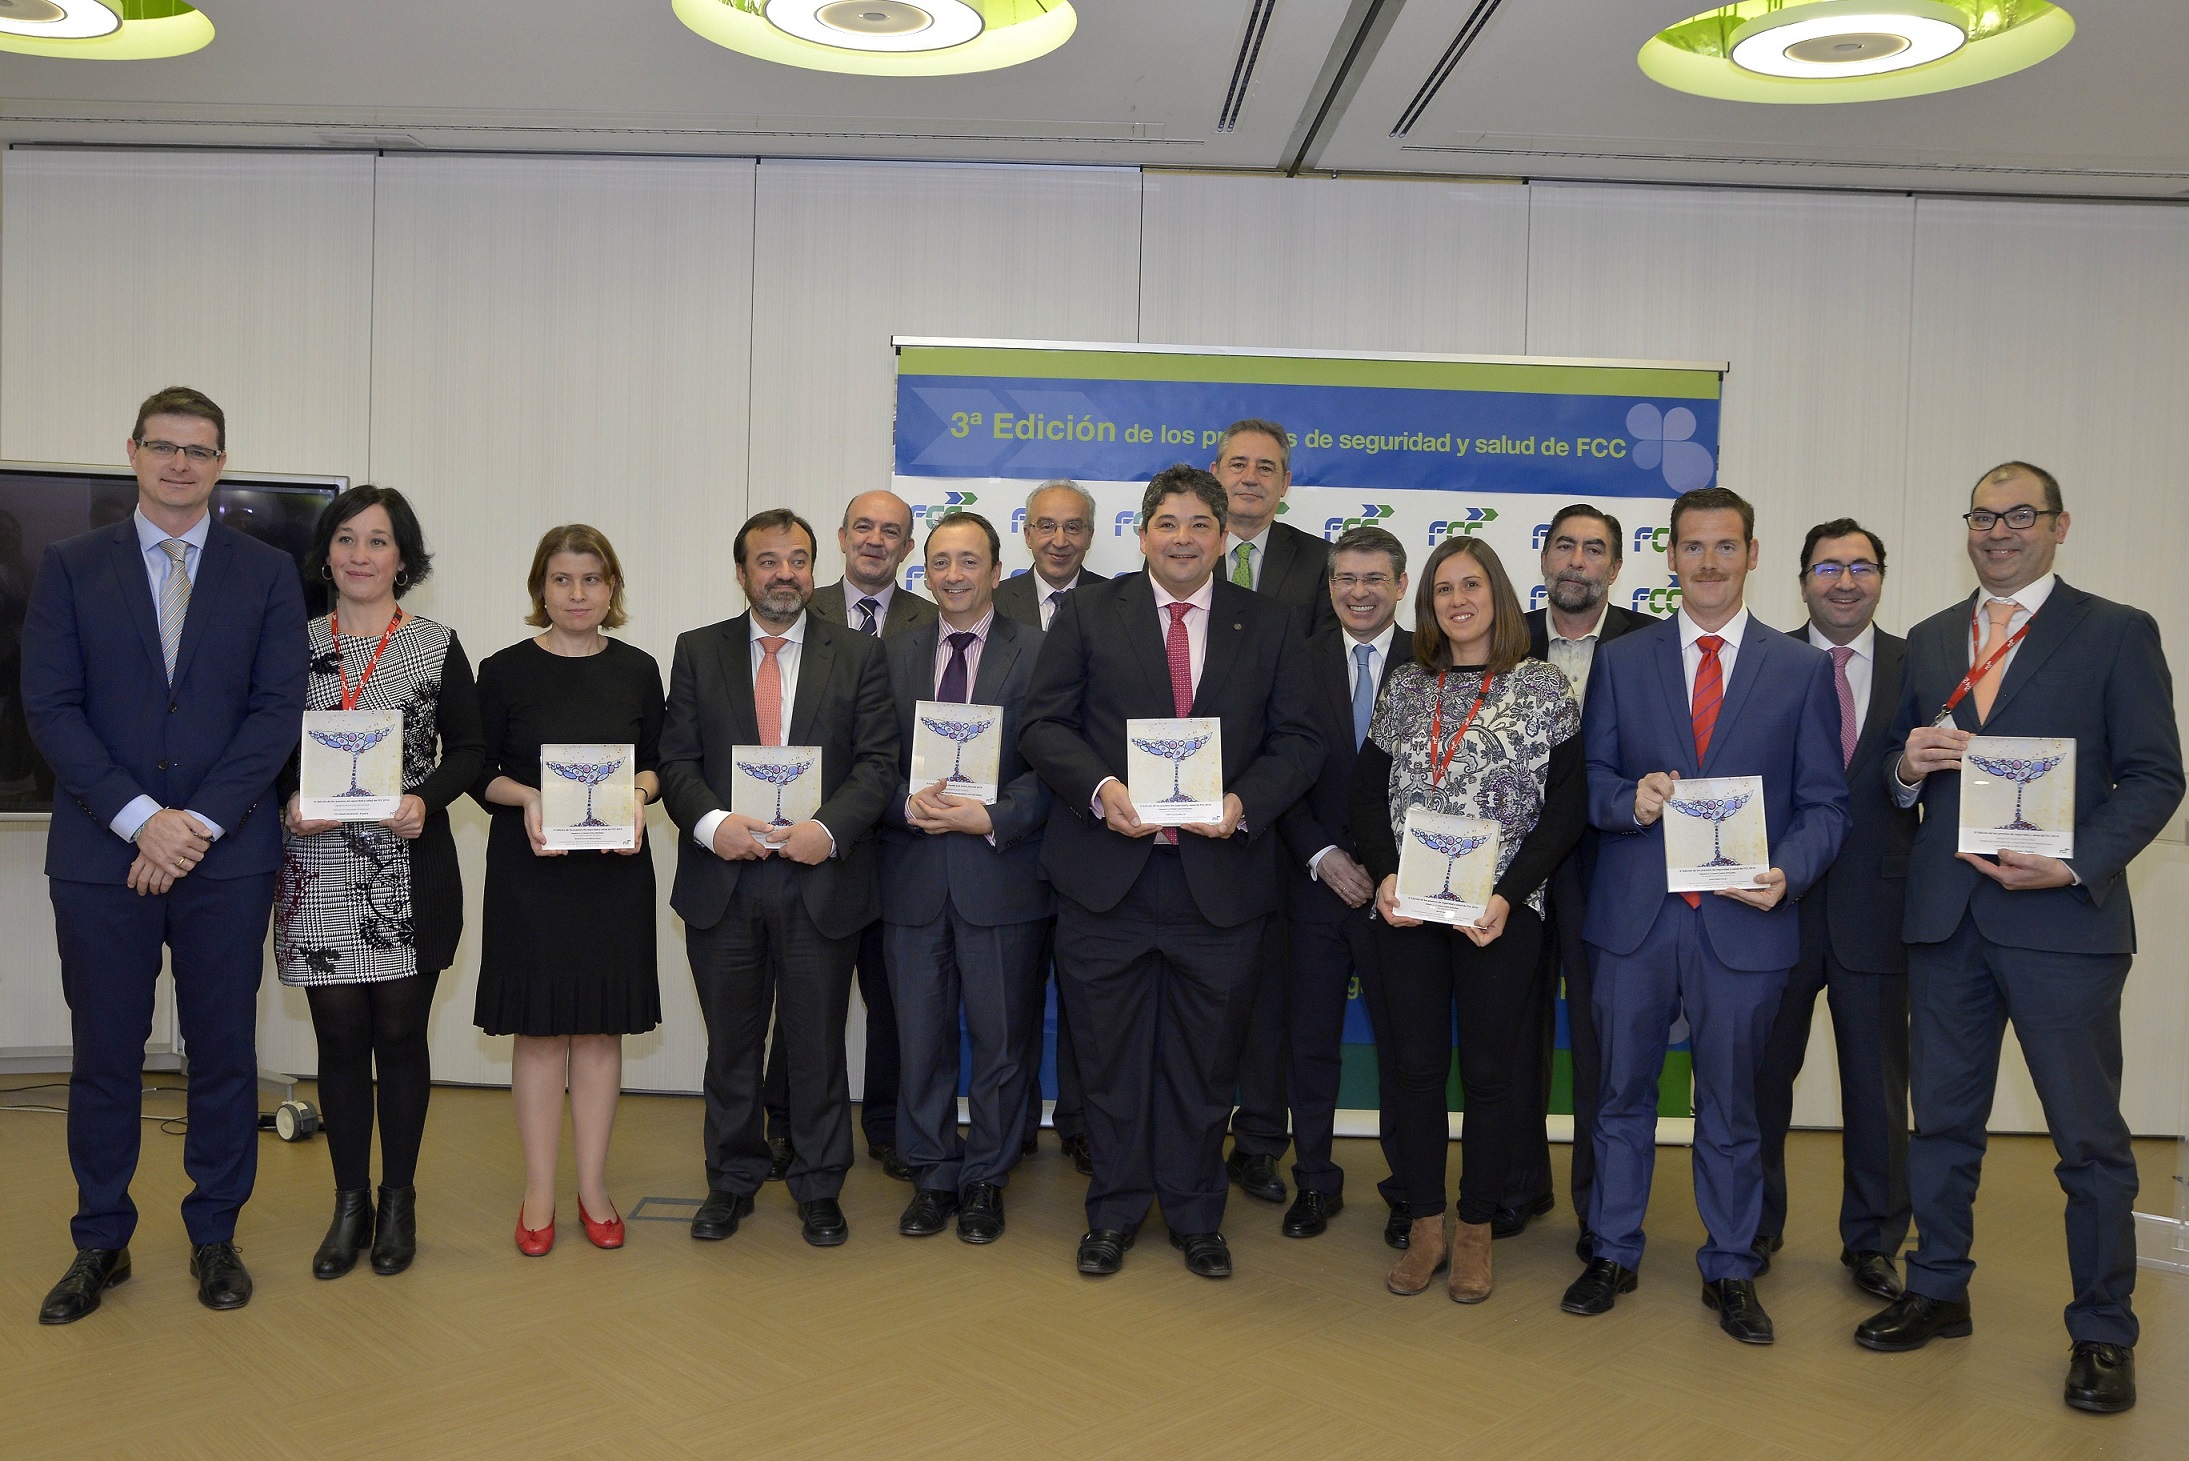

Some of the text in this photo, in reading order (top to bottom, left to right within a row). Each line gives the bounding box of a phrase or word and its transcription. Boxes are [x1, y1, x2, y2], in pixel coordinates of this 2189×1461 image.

[994, 412, 1116, 442] Edición
[1124, 424, 1153, 443] de
[1161, 424, 1195, 445] los
[1305, 429, 1333, 448] de
[1339, 432, 1451, 455] seguridad
[1457, 438, 1470, 457] y
[1475, 435, 1535, 455] salud
[1541, 437, 1570, 456] de
[1577, 437, 1627, 459] FCC
[1634, 526, 1669, 553] FC
